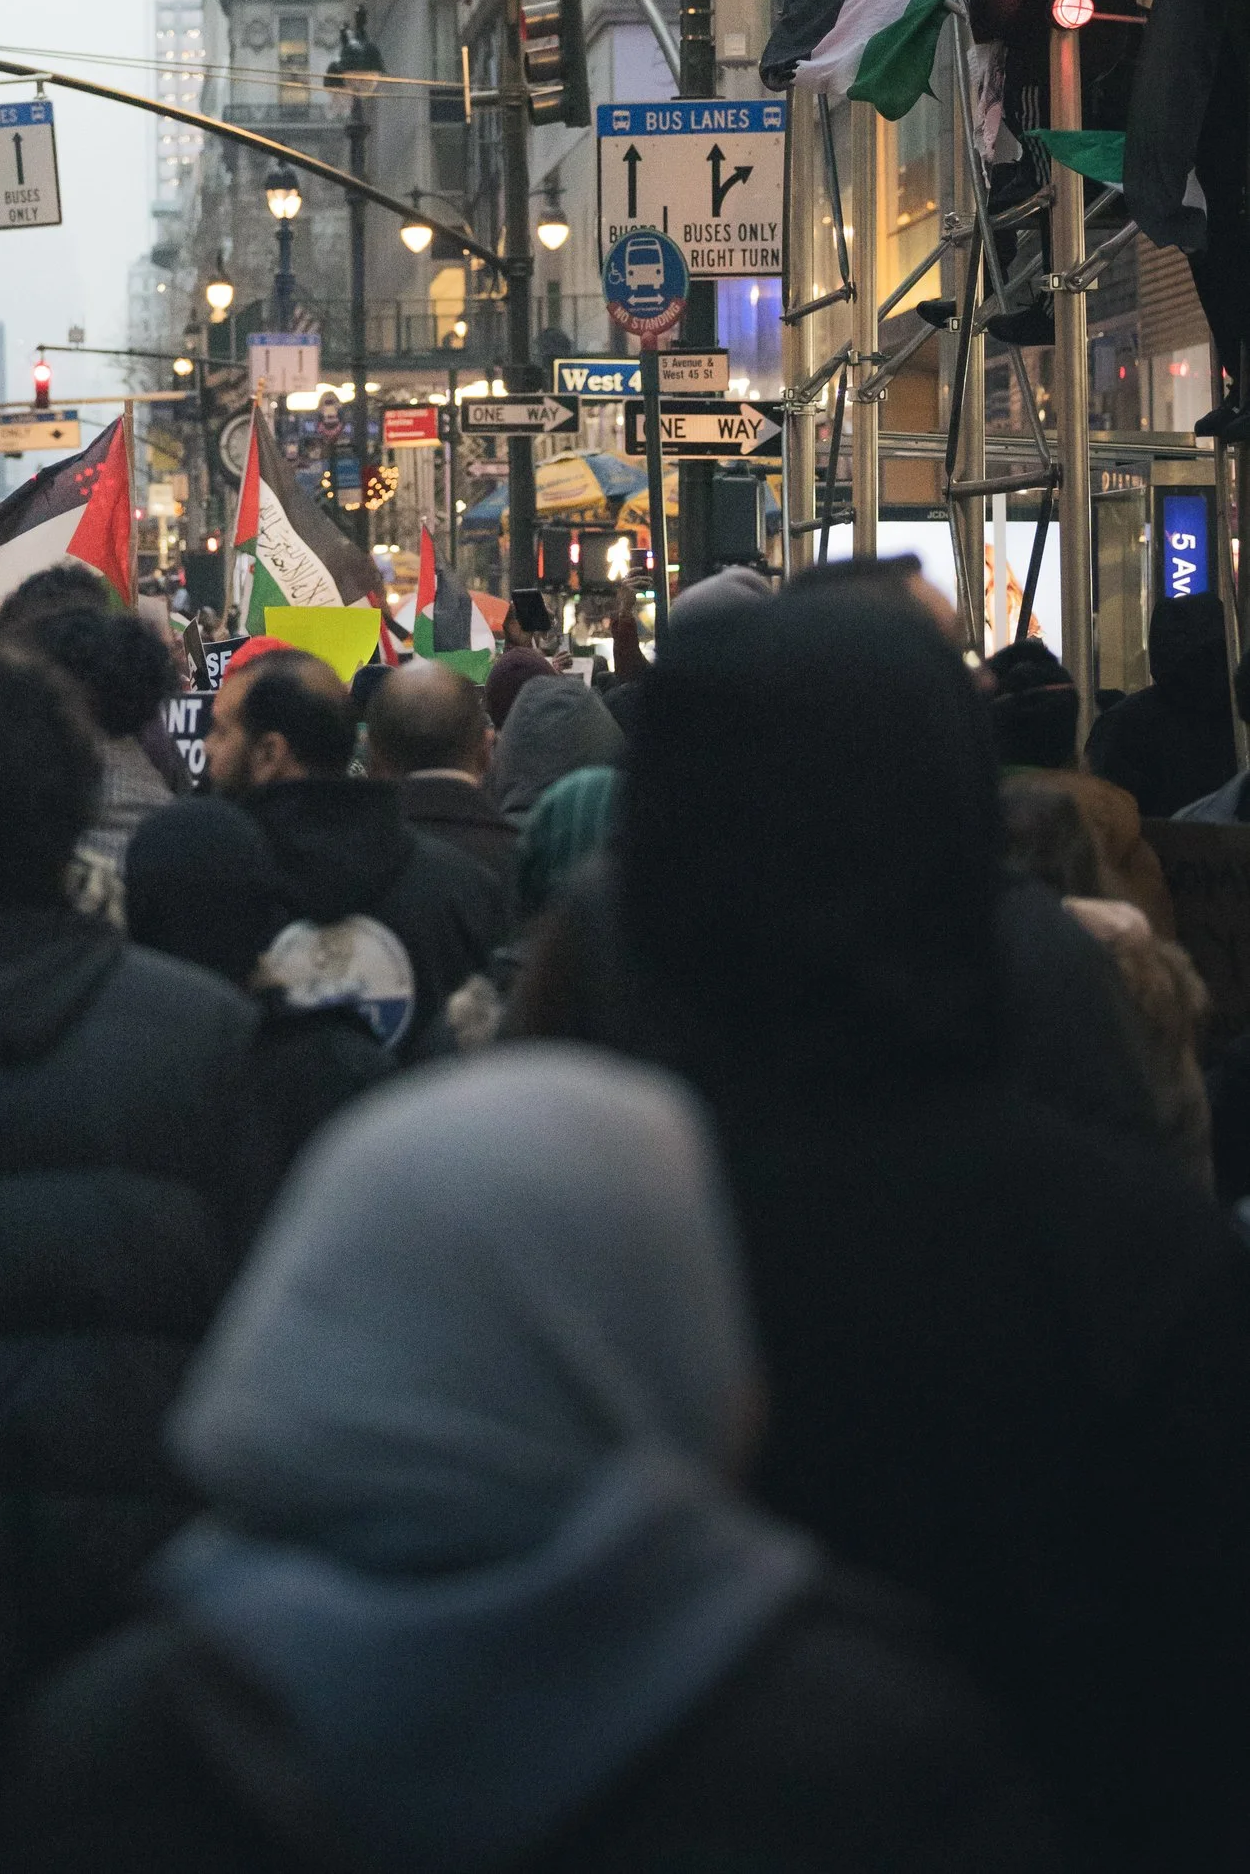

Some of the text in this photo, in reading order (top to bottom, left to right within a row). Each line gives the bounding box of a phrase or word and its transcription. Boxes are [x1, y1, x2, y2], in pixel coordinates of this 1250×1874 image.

[645, 109, 750, 131] BUS LANES
[4, 188, 40, 204] BUSES
[8, 207, 39, 223] ONLY
[684, 222, 778, 243] BUSES ONLY
[691, 248, 780, 268] RIGHT TURN
[614, 301, 681, 330] NO STANDING
[662, 357, 714, 368] 5 Avenue &
[561, 368, 642, 393] West 4
[663, 369, 713, 380] West 45 St
[473, 407, 560, 423] ONE WAY
[643, 417, 764, 439] NE WAY
[1172, 533, 1198, 599] 5 Av
